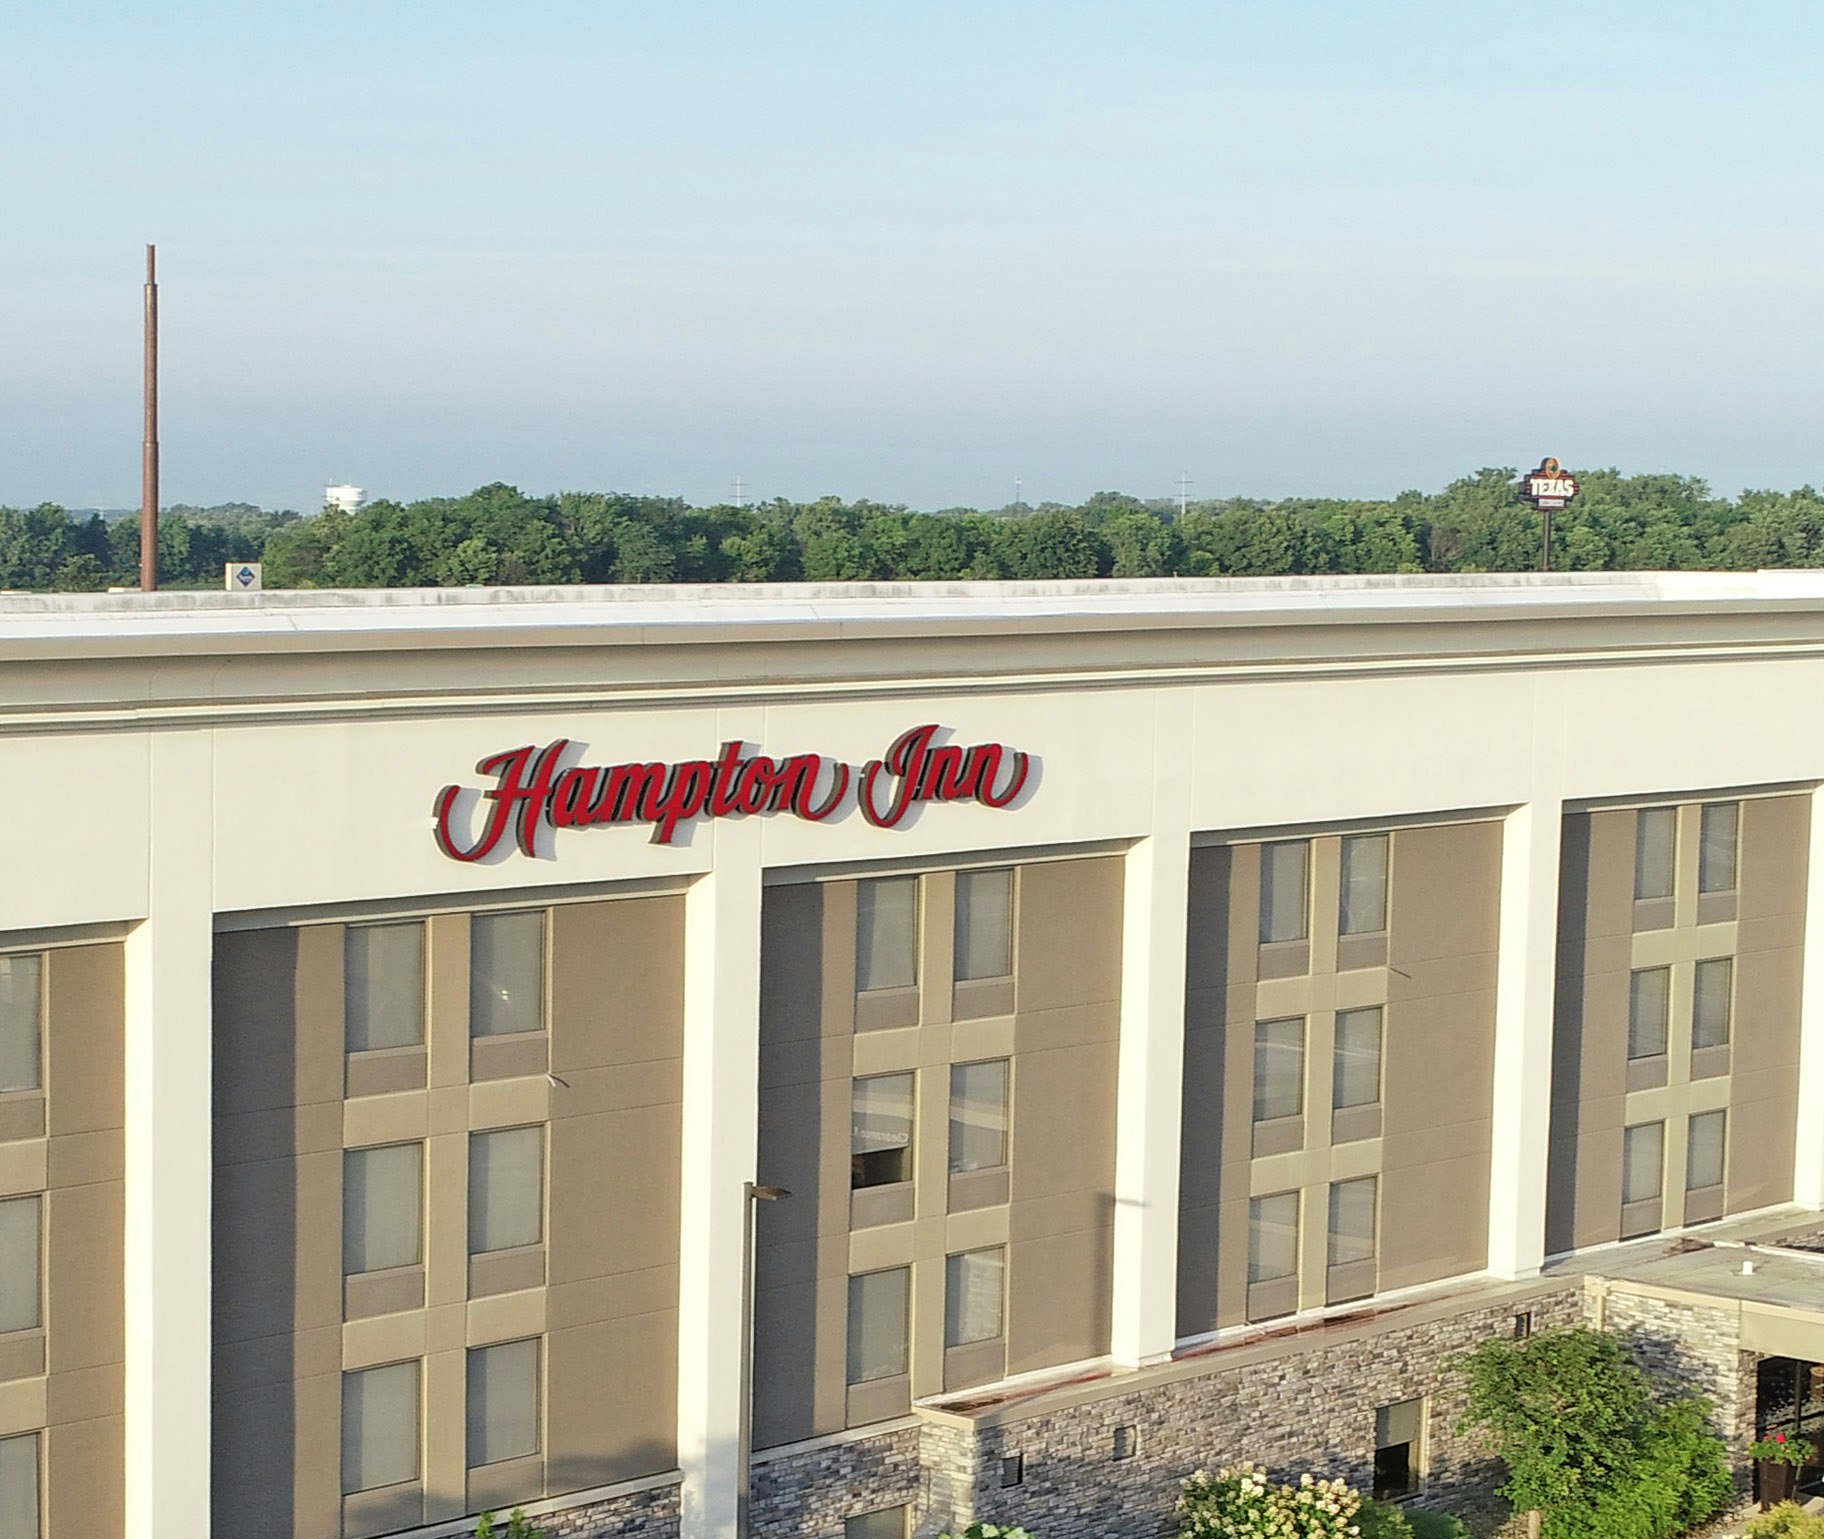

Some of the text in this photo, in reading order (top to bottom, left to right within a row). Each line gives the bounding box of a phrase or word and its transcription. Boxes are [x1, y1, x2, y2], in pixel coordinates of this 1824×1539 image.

[1530, 478, 1574, 497] TEXAS
[434, 724, 1028, 862] Hampton Inn
